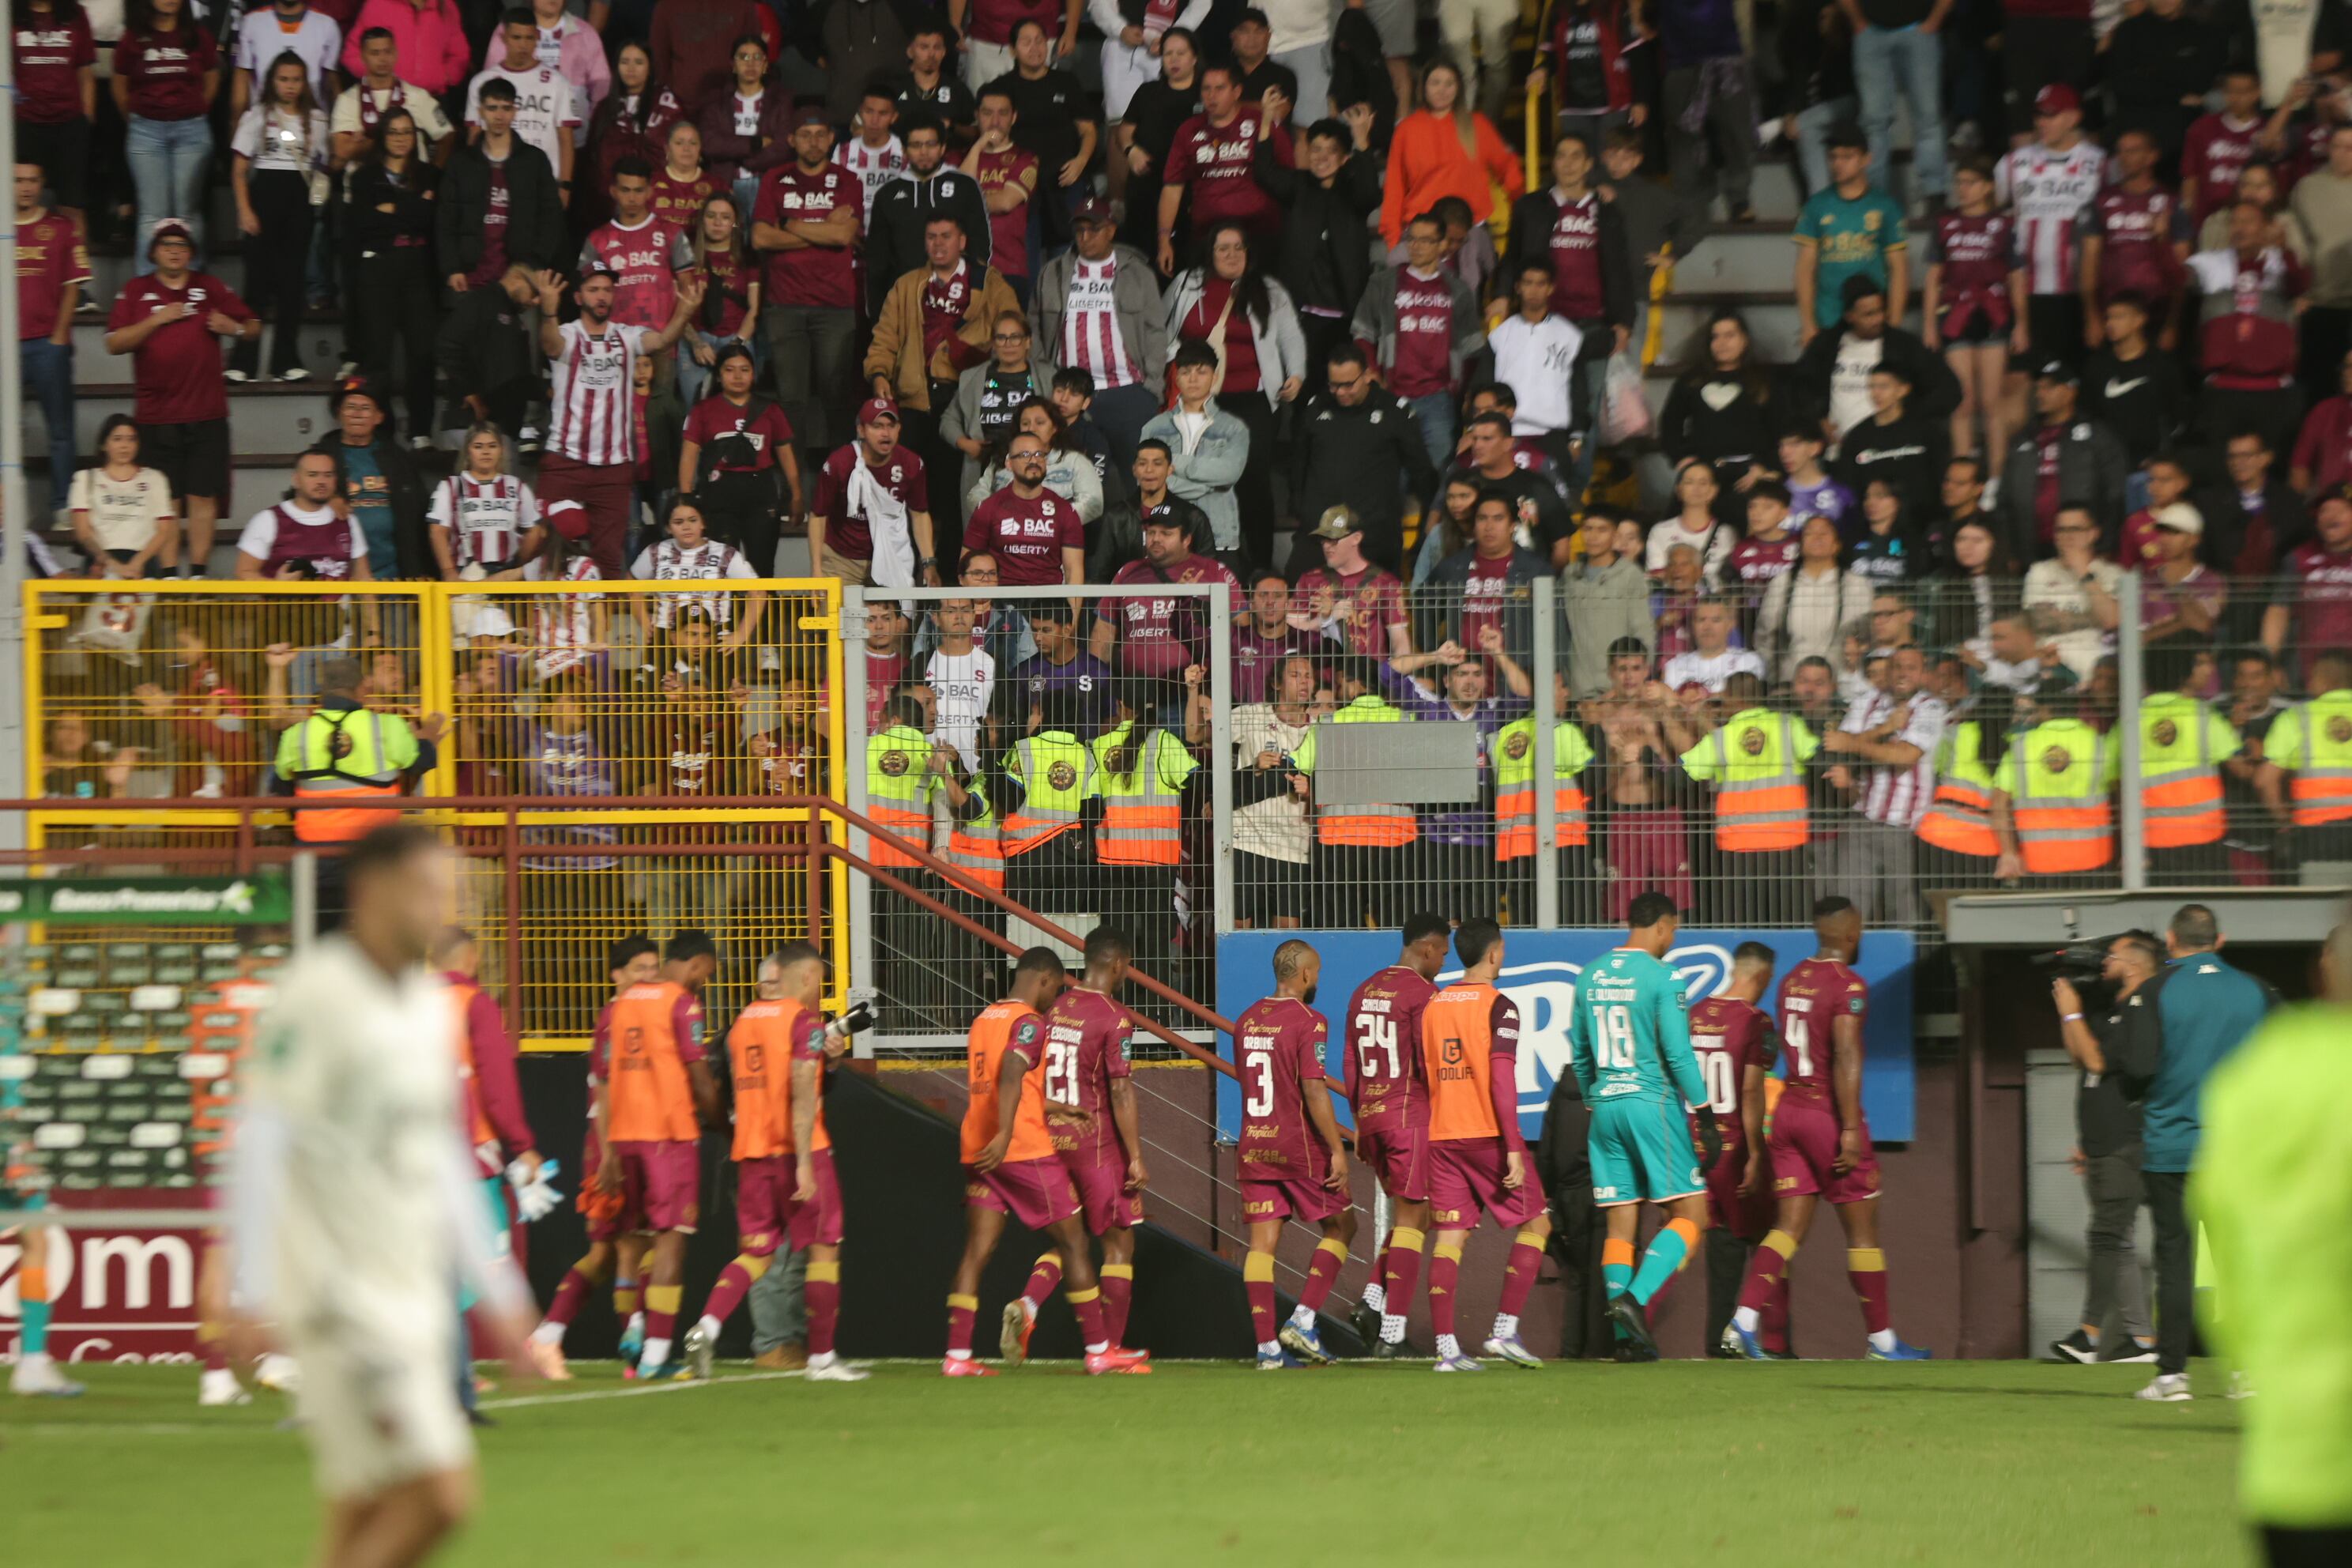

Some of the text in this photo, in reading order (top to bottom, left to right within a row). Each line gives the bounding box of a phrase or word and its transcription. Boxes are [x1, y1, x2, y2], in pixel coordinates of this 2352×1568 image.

[540, 70, 551, 83] S
[805, 191, 835, 205] BAC
[652, 231, 665, 247] S
[629, 251, 661, 267] BAC
[188, 288, 206, 301] S
[948, 281, 963, 300] S
[1069, 300, 1110, 310] LIBERT
[1419, 316, 1446, 330] BAC
[594, 353, 624, 371] BAC
[297, 417, 313, 434] 9
[980, 413, 1013, 424] LIBE
[891, 466, 903, 483] S
[1042, 499, 1055, 516] S
[1024, 518, 1054, 533] BAC
[1004, 545, 1050, 554] LIBERTY
[708, 555, 720, 566] S
[1152, 600, 1176, 615] BA
[1129, 628, 1173, 639] LIBERT
[974, 669, 986, 683] S
[1079, 675, 1092, 692] S
[949, 685, 980, 699] BAC
[1592, 1005, 1636, 1069] 18
[1785, 1013, 1815, 1076] 4
[1355, 1013, 1401, 1080] 24
[1045, 1042, 1081, 1106] 21
[1246, 1051, 1275, 1117] 3
[1246, 1125, 1280, 1140] Tropical
